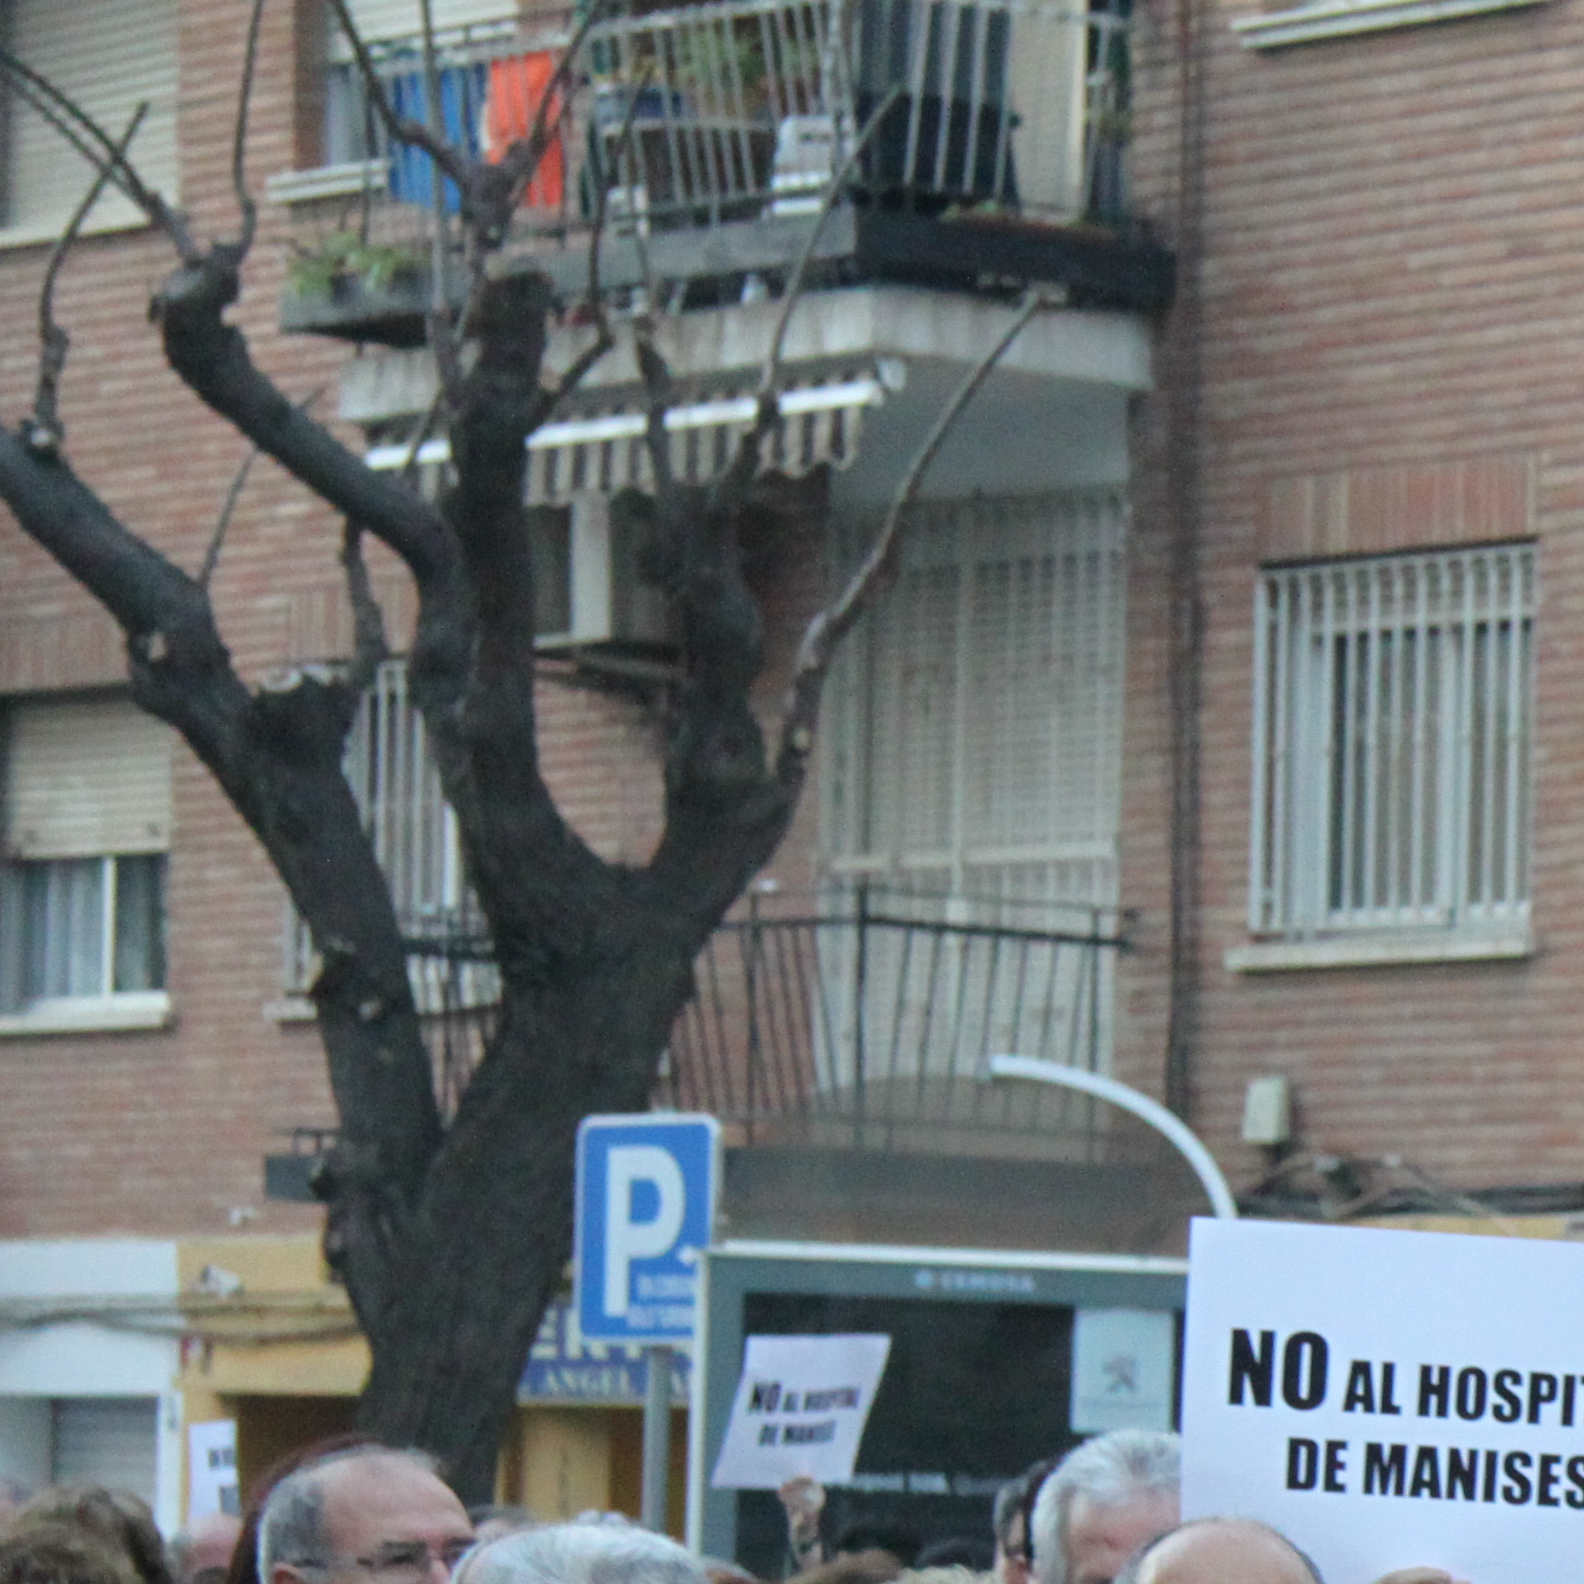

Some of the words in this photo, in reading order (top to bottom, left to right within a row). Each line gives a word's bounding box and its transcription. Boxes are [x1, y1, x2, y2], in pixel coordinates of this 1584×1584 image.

[603, 1143, 687, 1318] P
[749, 1381, 782, 1413] NO
[1228, 1328, 1329, 1411] NO
[1343, 1360, 1401, 1415] AL
[1286, 1437, 1348, 1493] DE
